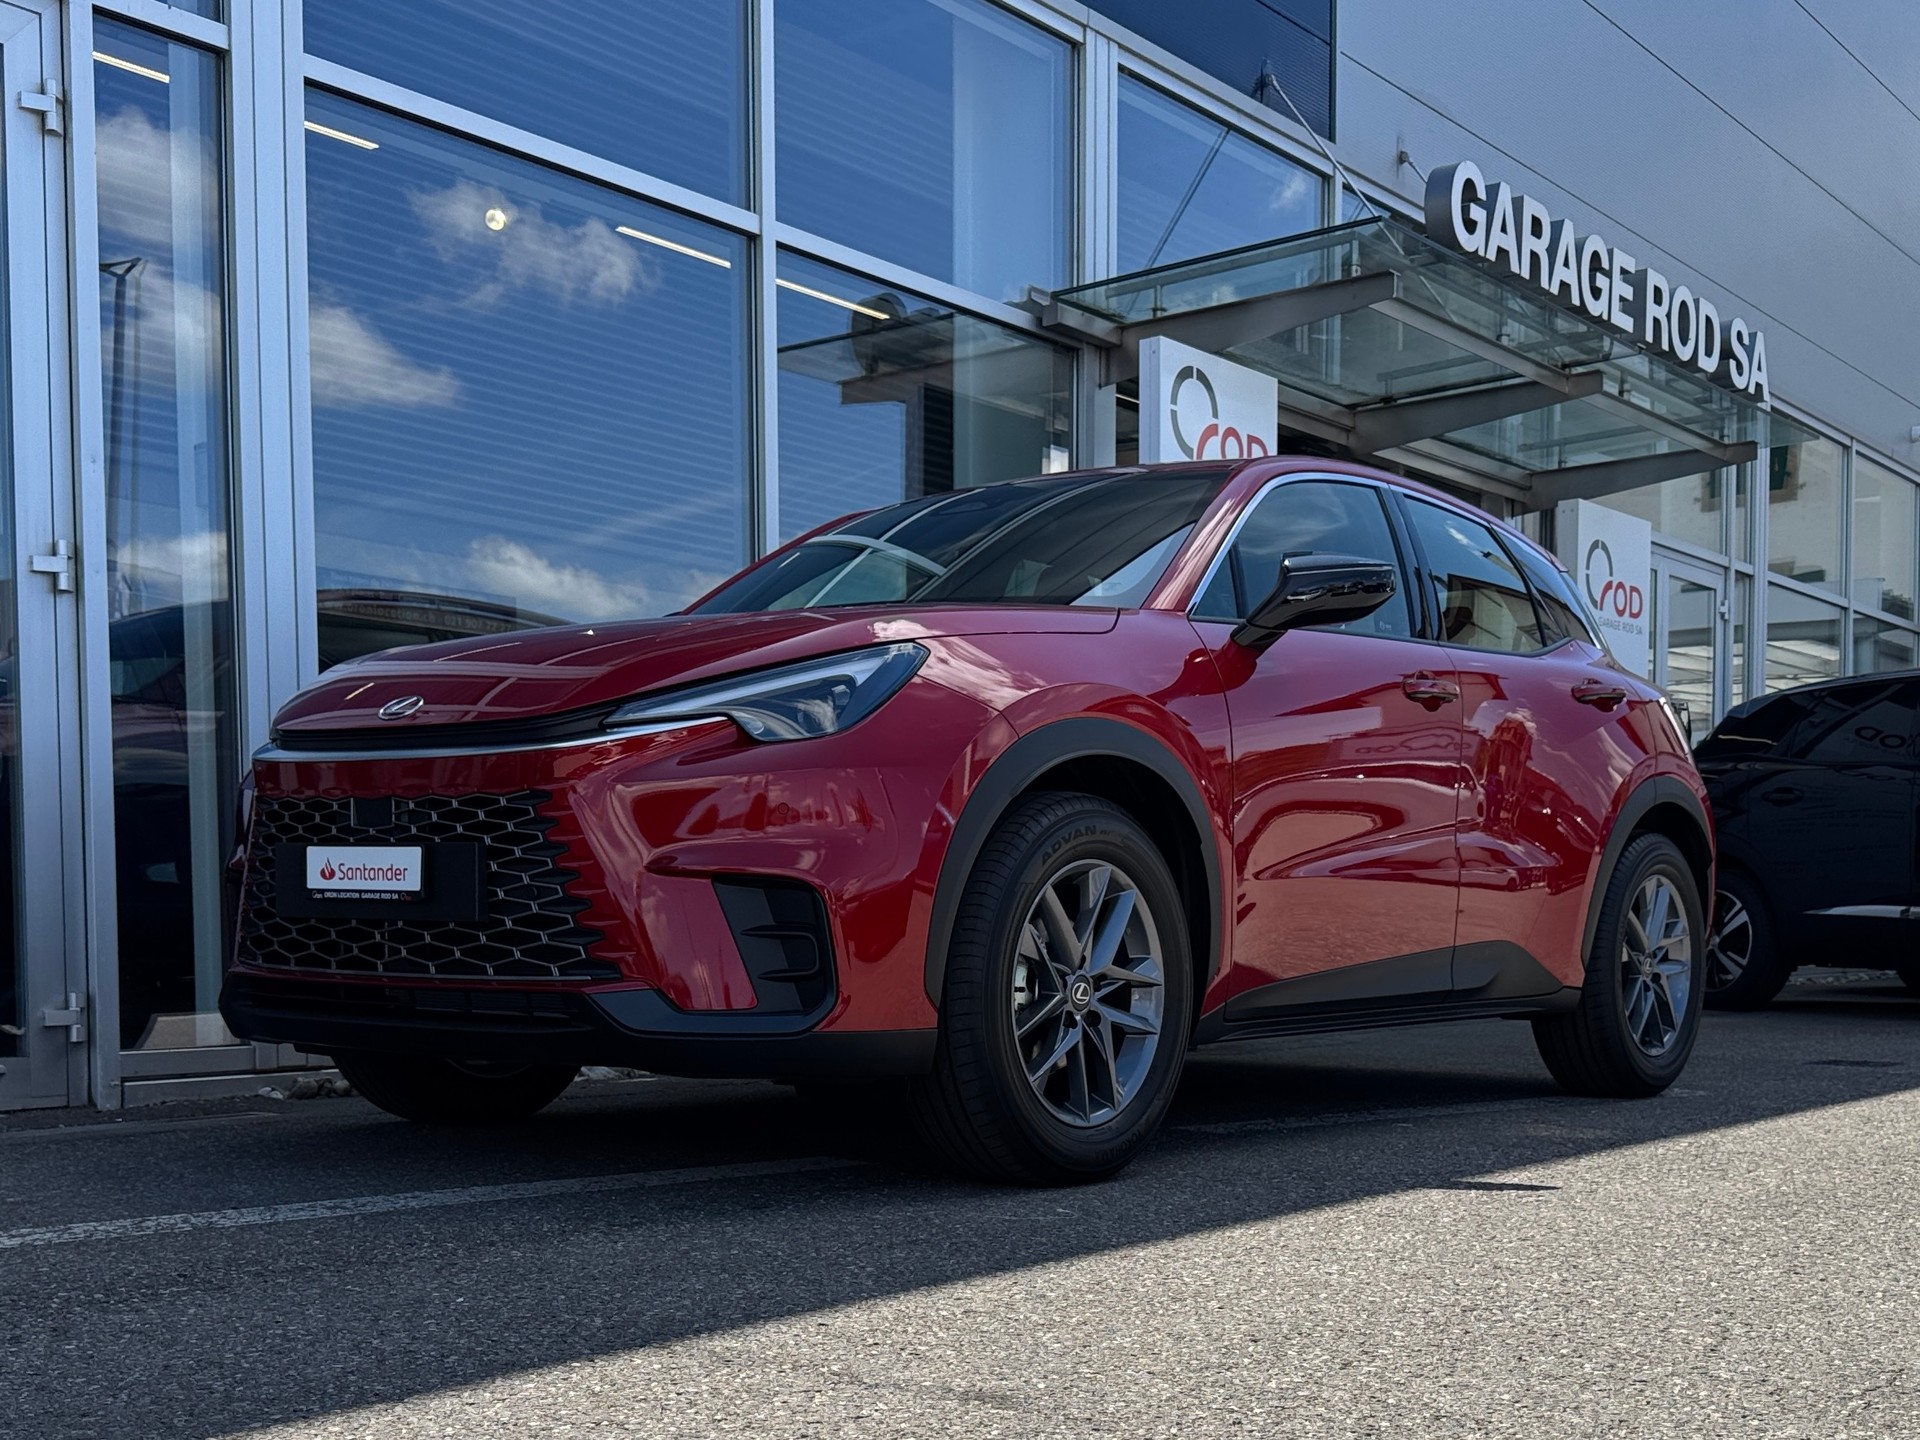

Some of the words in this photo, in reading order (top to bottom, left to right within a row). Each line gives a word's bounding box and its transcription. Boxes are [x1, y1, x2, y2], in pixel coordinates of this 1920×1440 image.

[1450, 160, 1636, 334] GARAGE
[1645, 268, 1721, 374] ROD
[1729, 317, 1771, 410] SA
[1599, 616, 1621, 631] GARAGE
[1041, 824, 1097, 865] ADVAN
[338, 863, 408, 882] Santander
